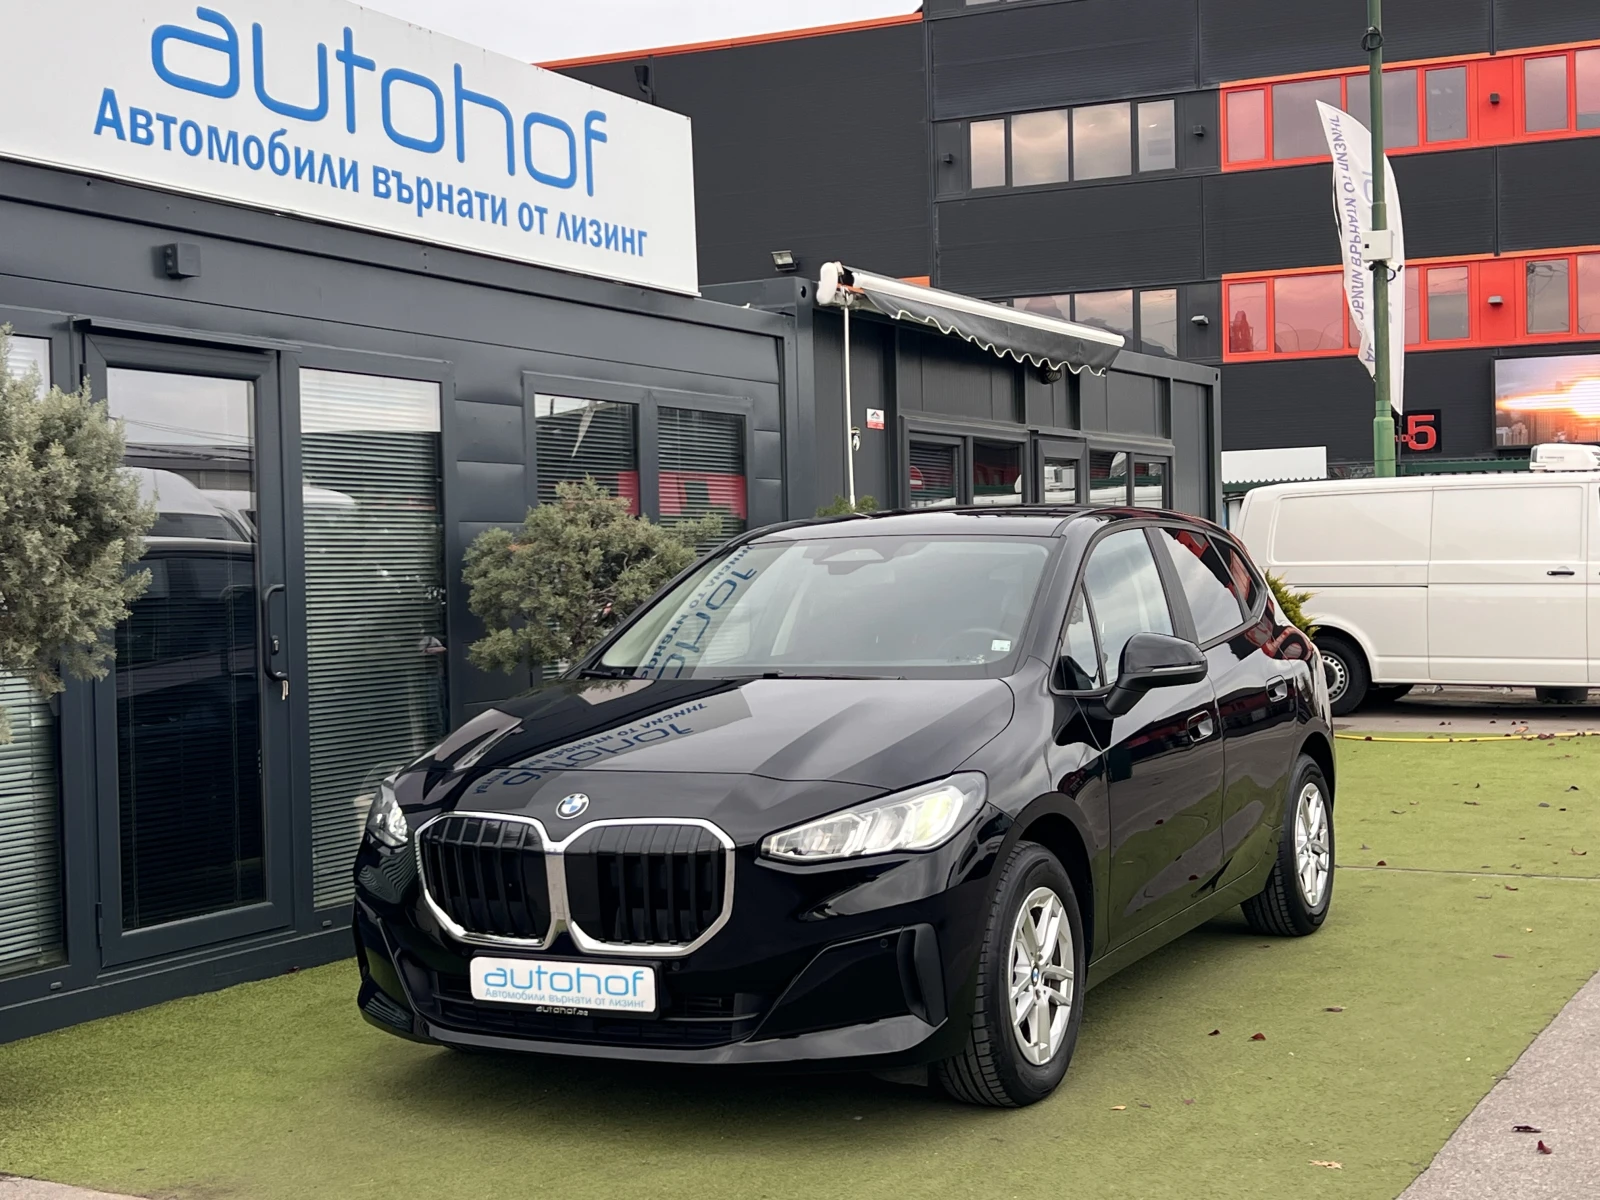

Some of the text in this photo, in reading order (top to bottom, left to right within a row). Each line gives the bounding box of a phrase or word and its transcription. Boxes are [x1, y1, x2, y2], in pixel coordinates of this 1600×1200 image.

[151, 6, 608, 197] autohof
[93, 87, 648, 258] Автомобили върнати от лизинг
[1407, 414, 1437, 451] 5
[484, 965, 644, 997] autohof
[485, 987, 646, 1009] Автомобили върнати от лизинг
